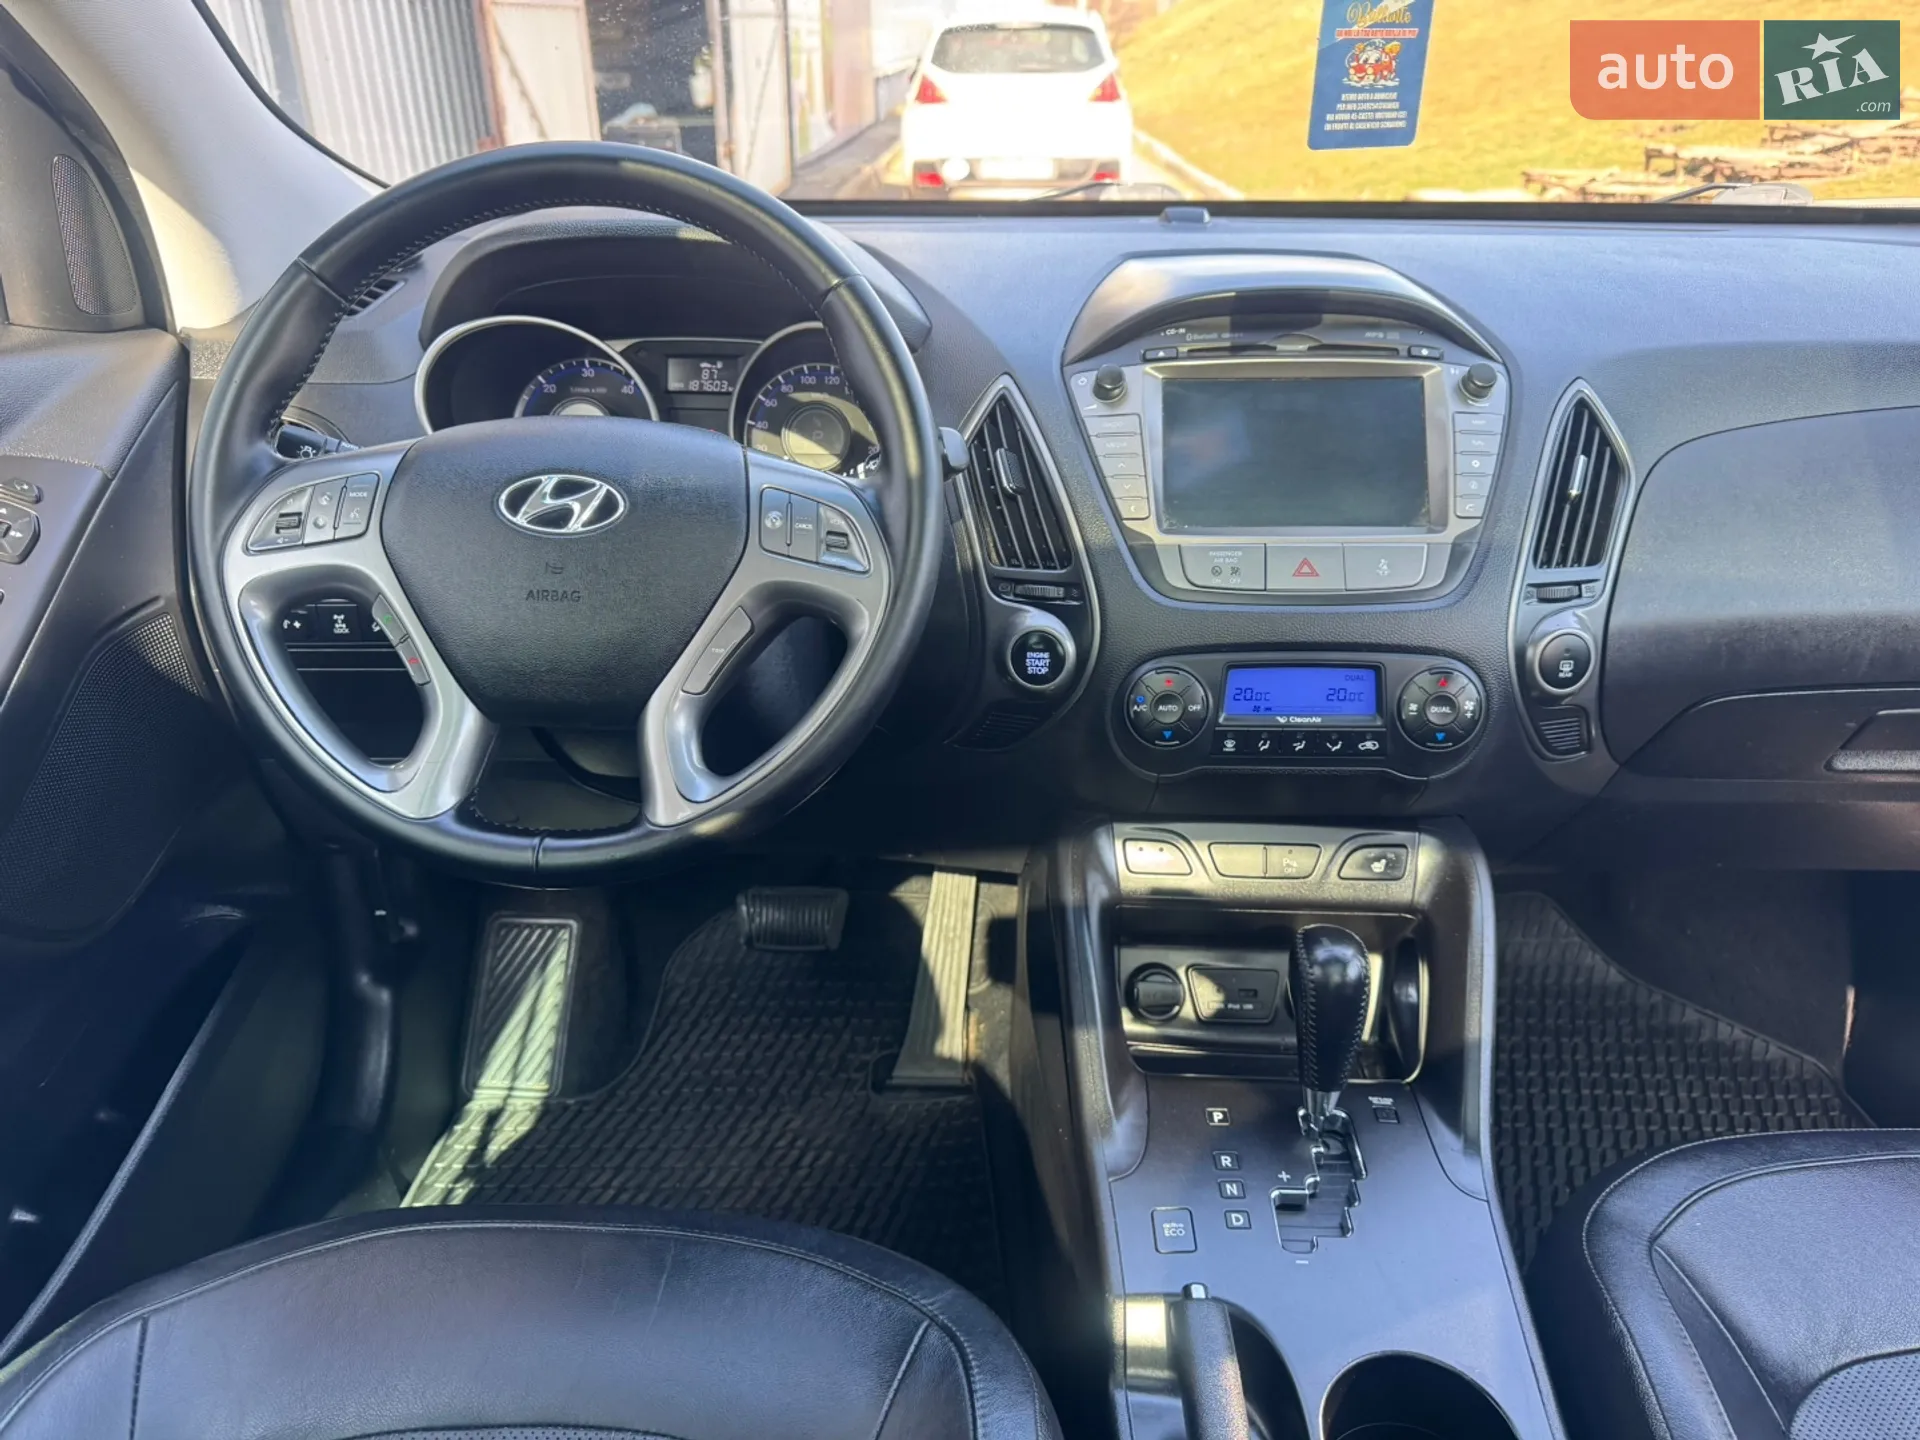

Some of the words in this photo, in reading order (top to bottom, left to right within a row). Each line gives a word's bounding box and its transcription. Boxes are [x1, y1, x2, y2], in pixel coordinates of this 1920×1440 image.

[580, 368, 595, 378] 30
[701, 369, 718, 380] 87
[800, 375, 816, 385] 100
[824, 375, 840, 385] 120
[542, 384, 557, 394] 20
[621, 385, 635, 395] 40
[689, 380, 729, 392] 187603
[780, 384, 794, 393] 80
[764, 399, 778, 407] 60
[756, 421, 768, 429] 40
[525, 589, 582, 603] AIRBAG
[1025, 659, 1051, 667] START
[1027, 667, 1049, 675] STOP
[1133, 704, 1148, 712] A/C
[1157, 704, 1179, 712] AUTO
[1187, 704, 1201, 712] OFF
[1212, 1111, 1224, 1123] P
[1220, 1155, 1232, 1168] R
[1225, 1183, 1238, 1196] N
[1230, 1213, 1244, 1226] D
[1163, 1228, 1186, 1237] ECO
